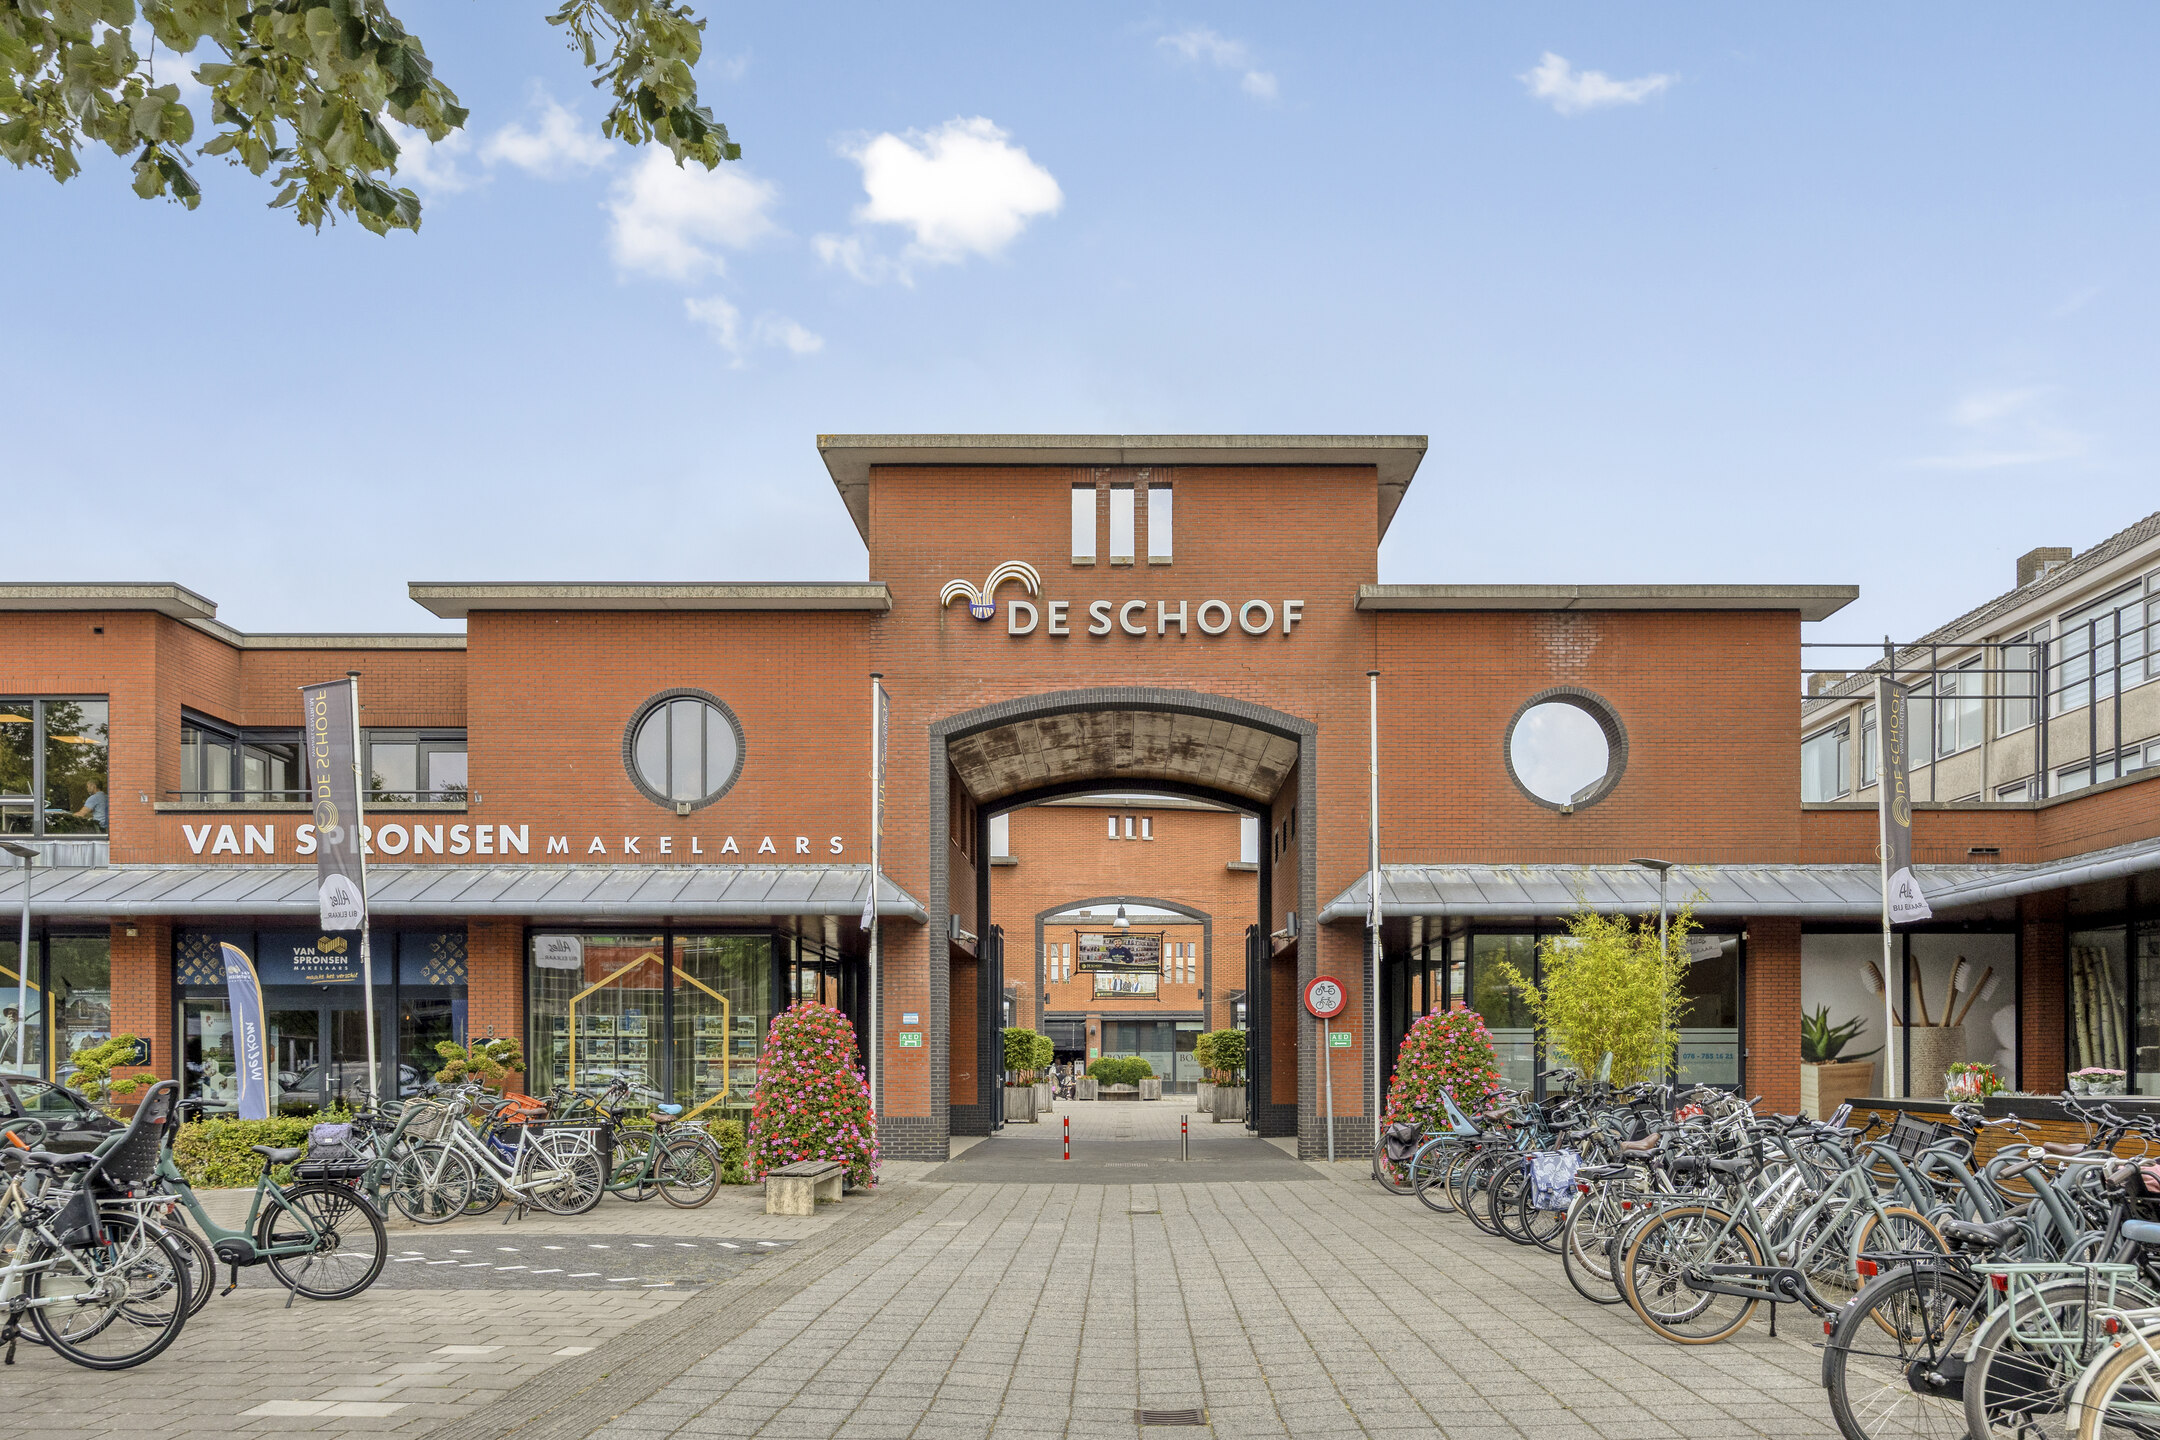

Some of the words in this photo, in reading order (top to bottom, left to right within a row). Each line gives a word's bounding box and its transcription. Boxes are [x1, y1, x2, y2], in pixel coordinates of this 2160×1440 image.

[1007, 600, 1070, 635] DE
[1088, 599, 1305, 635] SCHOOF
[1890, 687, 1901, 765] SCHOOF
[182, 824, 275, 855] VAN
[295, 823, 529, 856] SPRONSEN
[546, 836, 844, 855] MAKELAARS
[293, 947, 315, 955] VAN
[293, 956, 348, 964] SPRONSEN
[487, 1024, 494, 1037] 8
